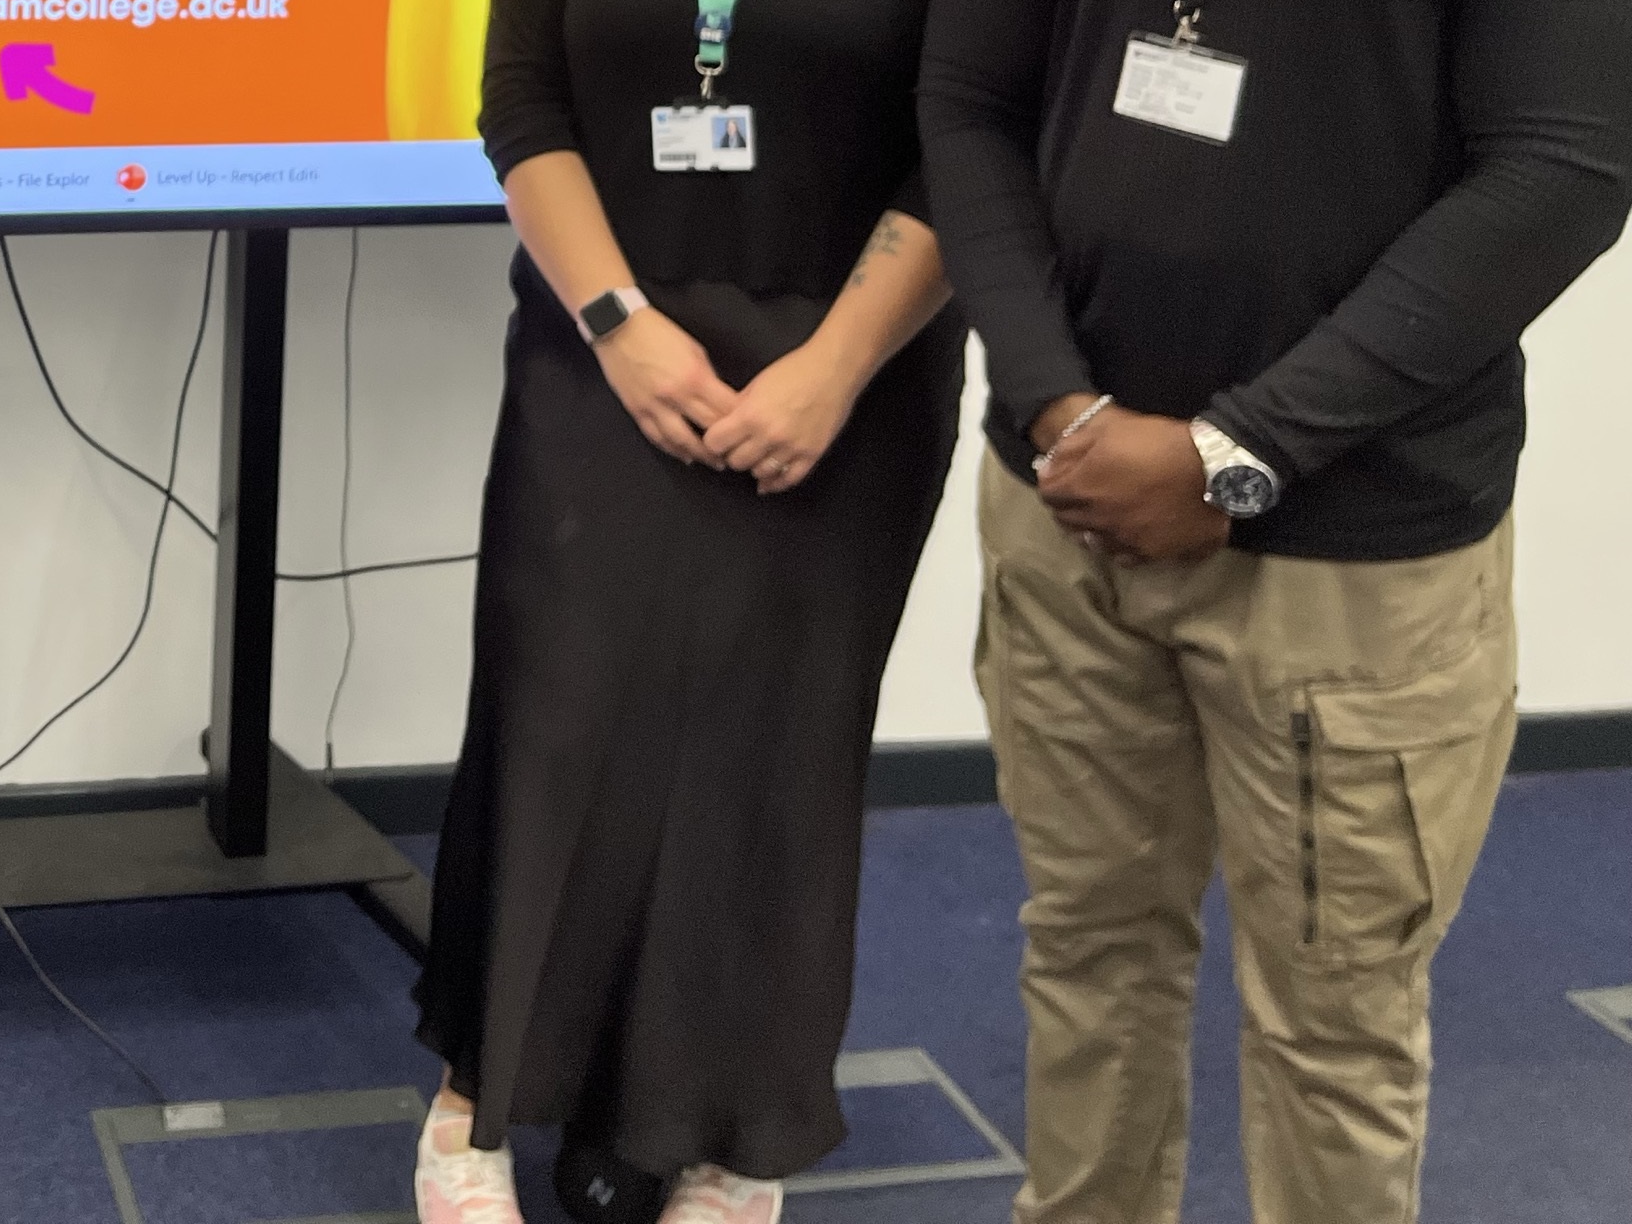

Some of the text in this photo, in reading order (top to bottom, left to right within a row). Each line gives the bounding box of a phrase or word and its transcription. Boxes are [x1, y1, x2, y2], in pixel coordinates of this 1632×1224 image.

[18, 172, 42, 188] File
[46, 171, 90, 189] Explor
[157, 169, 193, 185] Level
[196, 169, 217, 186] Up
